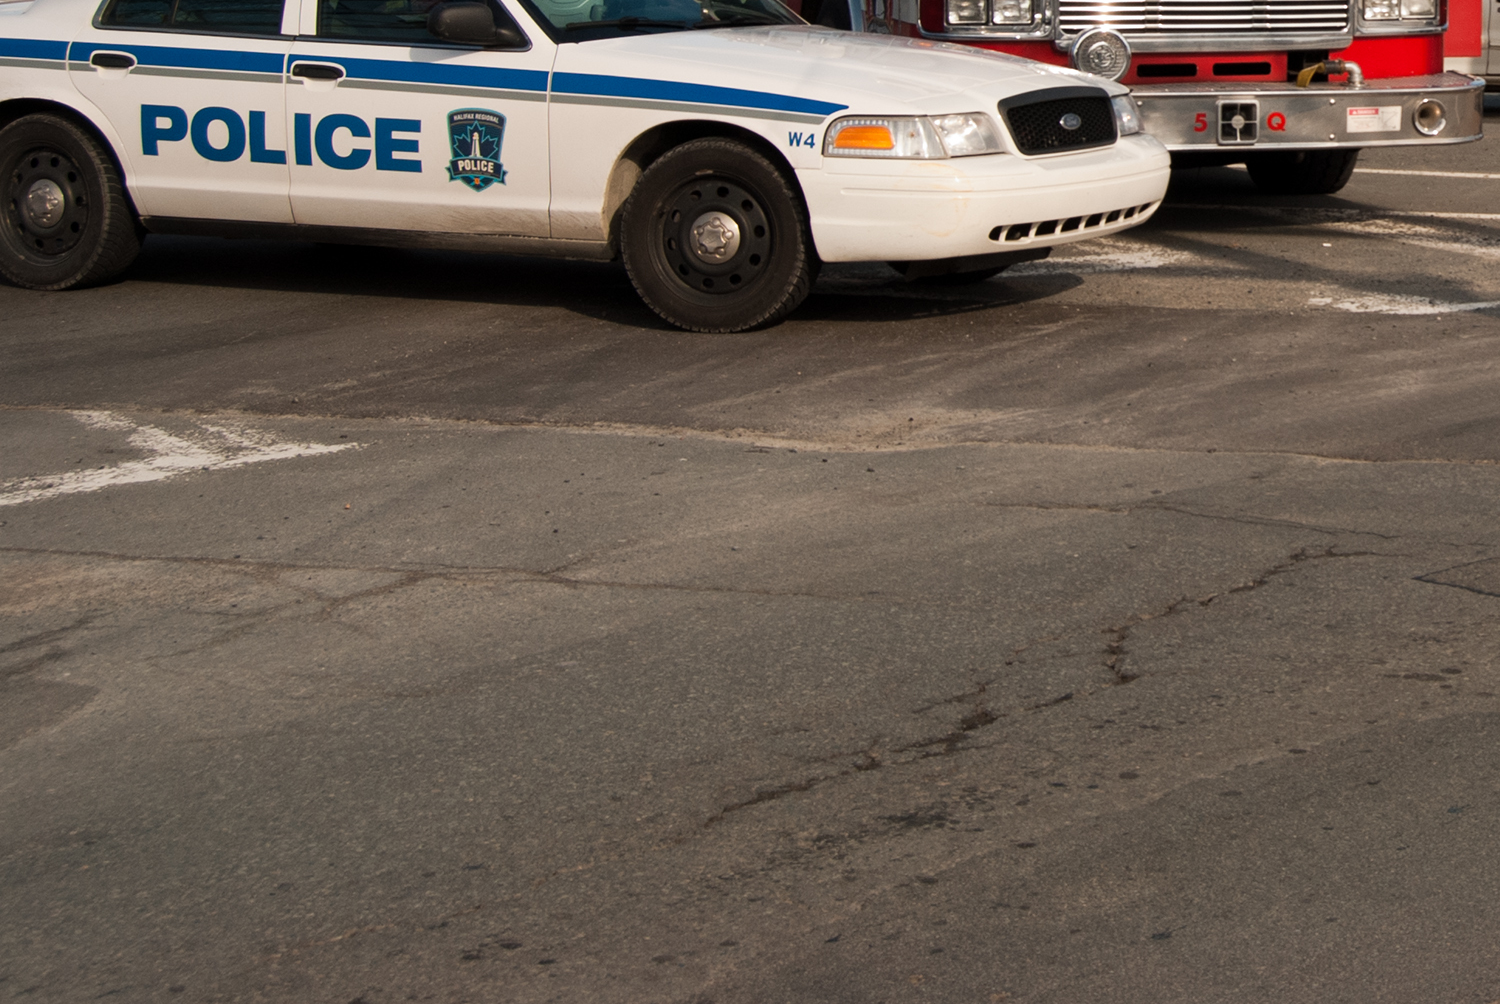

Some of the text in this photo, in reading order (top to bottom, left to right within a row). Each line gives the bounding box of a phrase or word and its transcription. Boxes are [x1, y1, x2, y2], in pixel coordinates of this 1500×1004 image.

[453, 113, 500, 124] HALIFAX REGIONAL
[1194, 111, 1287, 132] 5 Q
[140, 103, 423, 173] POLICE
[788, 131, 816, 149] W4
[457, 159, 495, 173] POLICE
